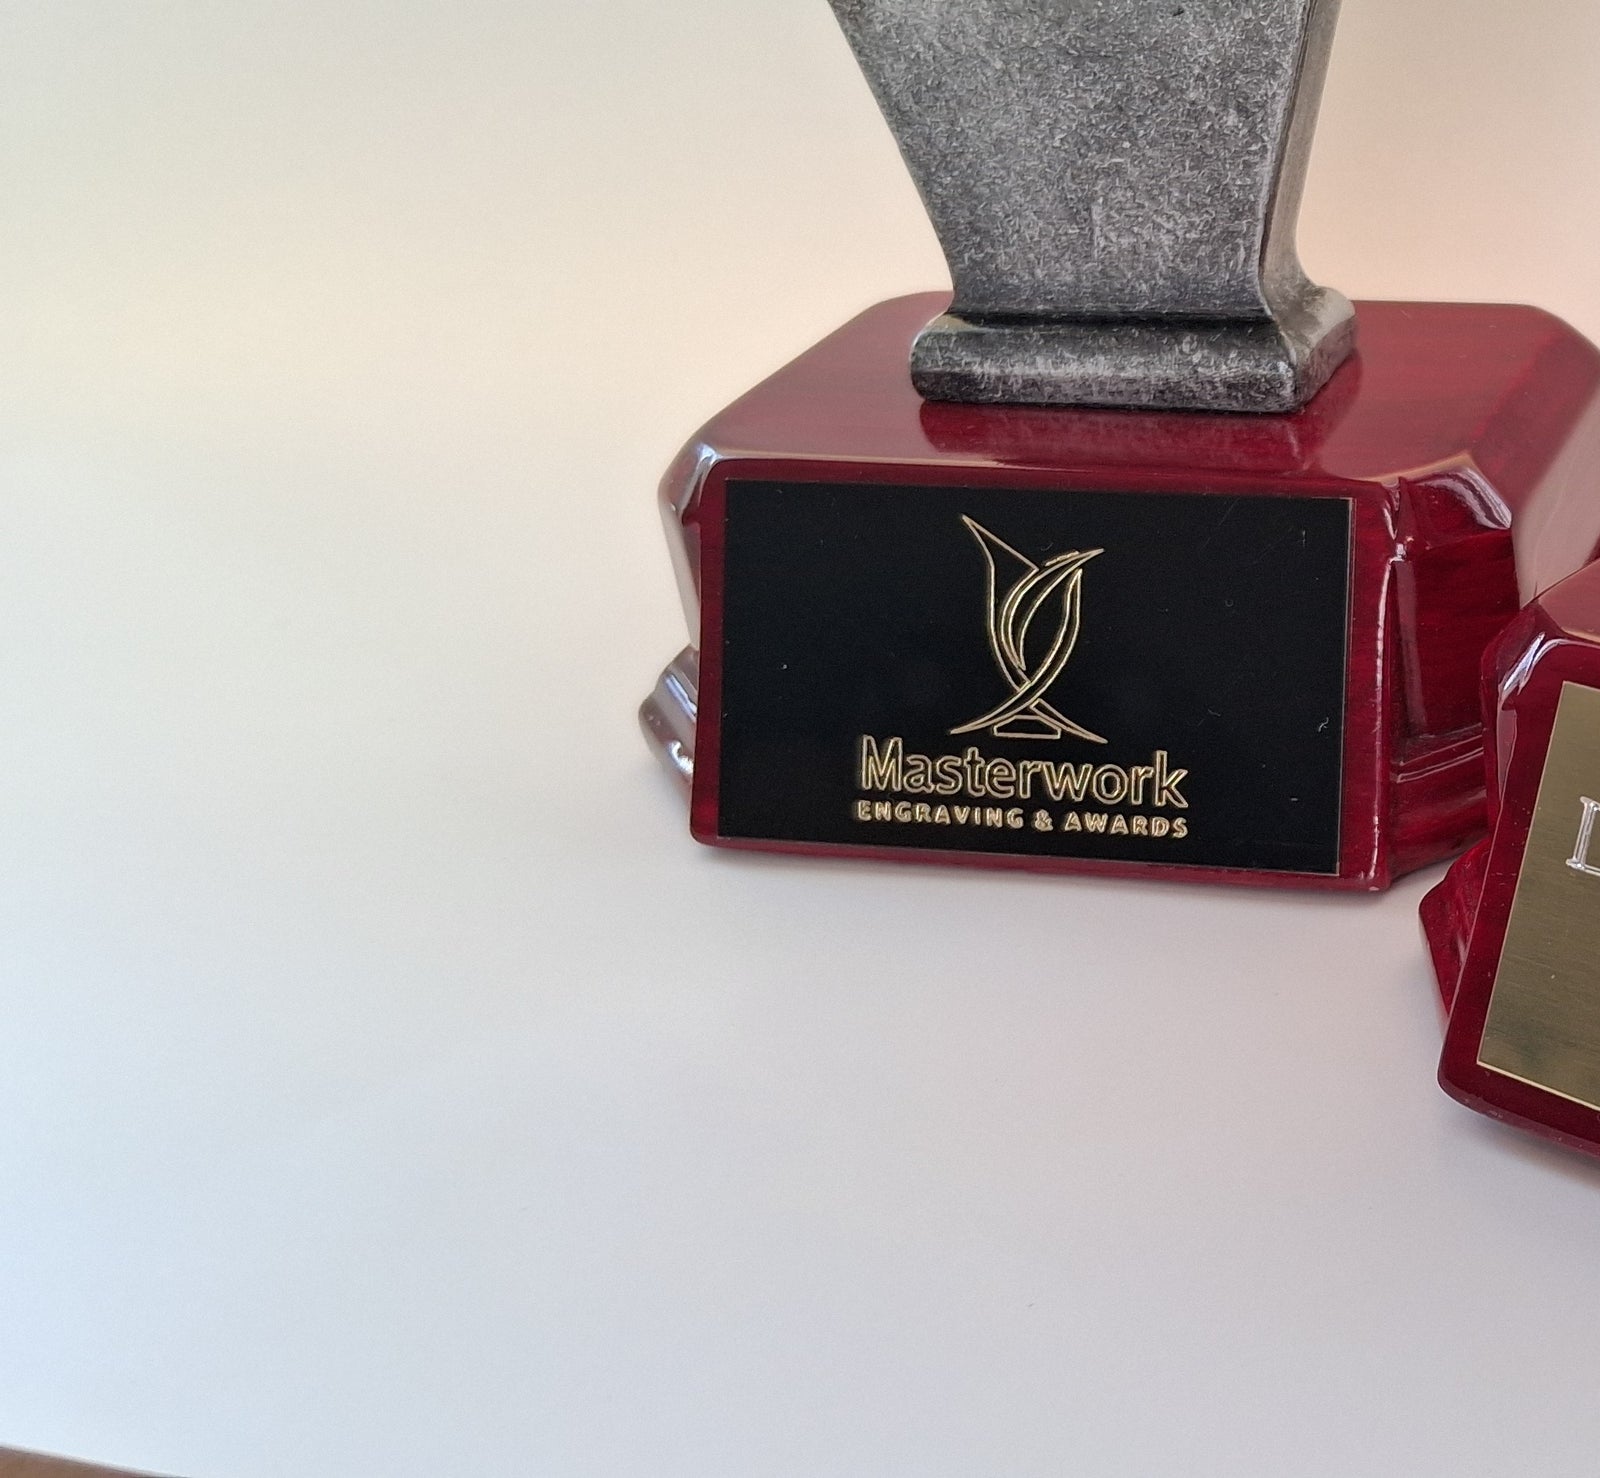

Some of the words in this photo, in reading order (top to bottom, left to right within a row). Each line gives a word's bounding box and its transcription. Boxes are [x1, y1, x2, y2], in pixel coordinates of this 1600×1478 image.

[860, 734, 1189, 809] Masterwork
[855, 800, 1025, 830] ENGRAVING
[1034, 808, 1054, 832] &
[1064, 811, 1188, 839] AWARDS
